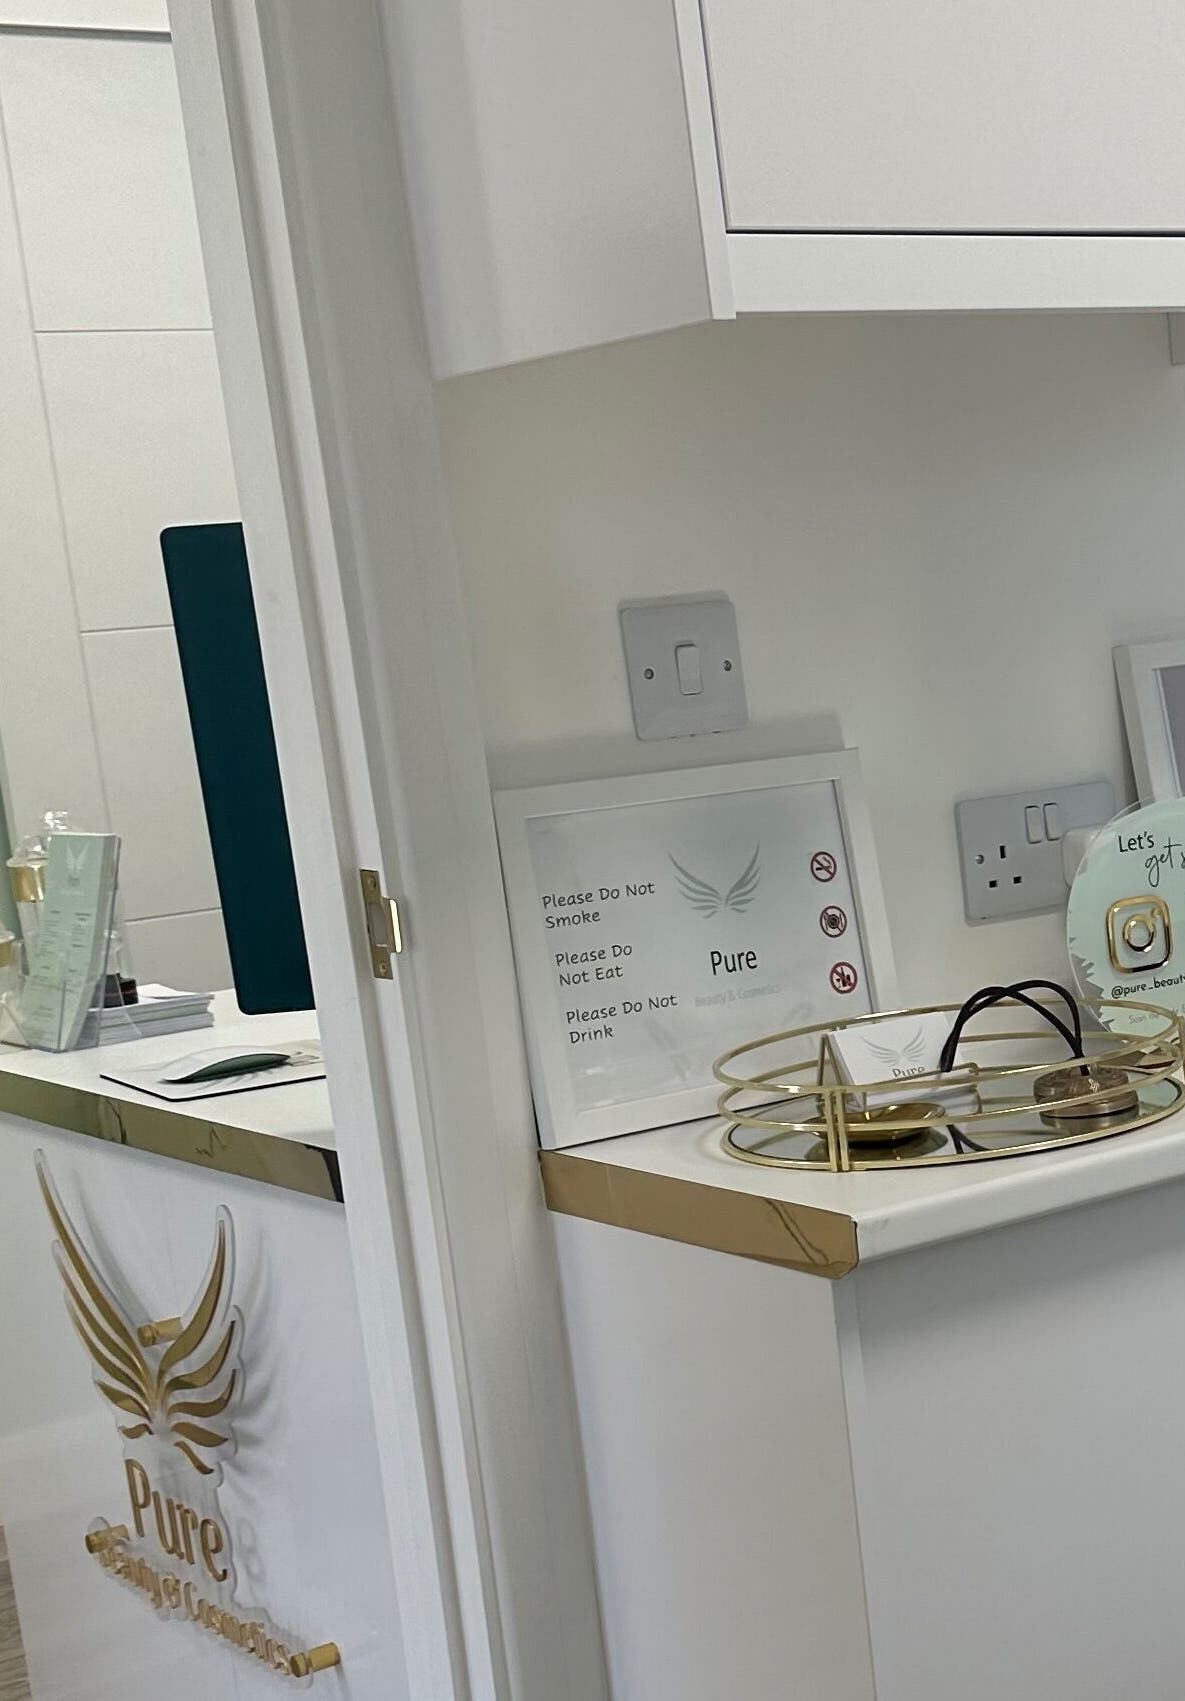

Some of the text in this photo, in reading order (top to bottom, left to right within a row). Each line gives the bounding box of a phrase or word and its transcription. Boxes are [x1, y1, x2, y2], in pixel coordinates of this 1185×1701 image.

[1118, 831, 1155, 852] Let's
[1145, 837, 1182, 887] get
[542, 882, 655, 909] Please Do Not
[545, 910, 601, 928] Smoke
[555, 945, 633, 967] Please Do
[710, 950, 758, 975] Pure
[559, 965, 624, 986] Not Eat
[566, 994, 678, 1023] Please Do Not
[569, 1025, 614, 1044] Drink
[125, 1459, 228, 1582] Pure
